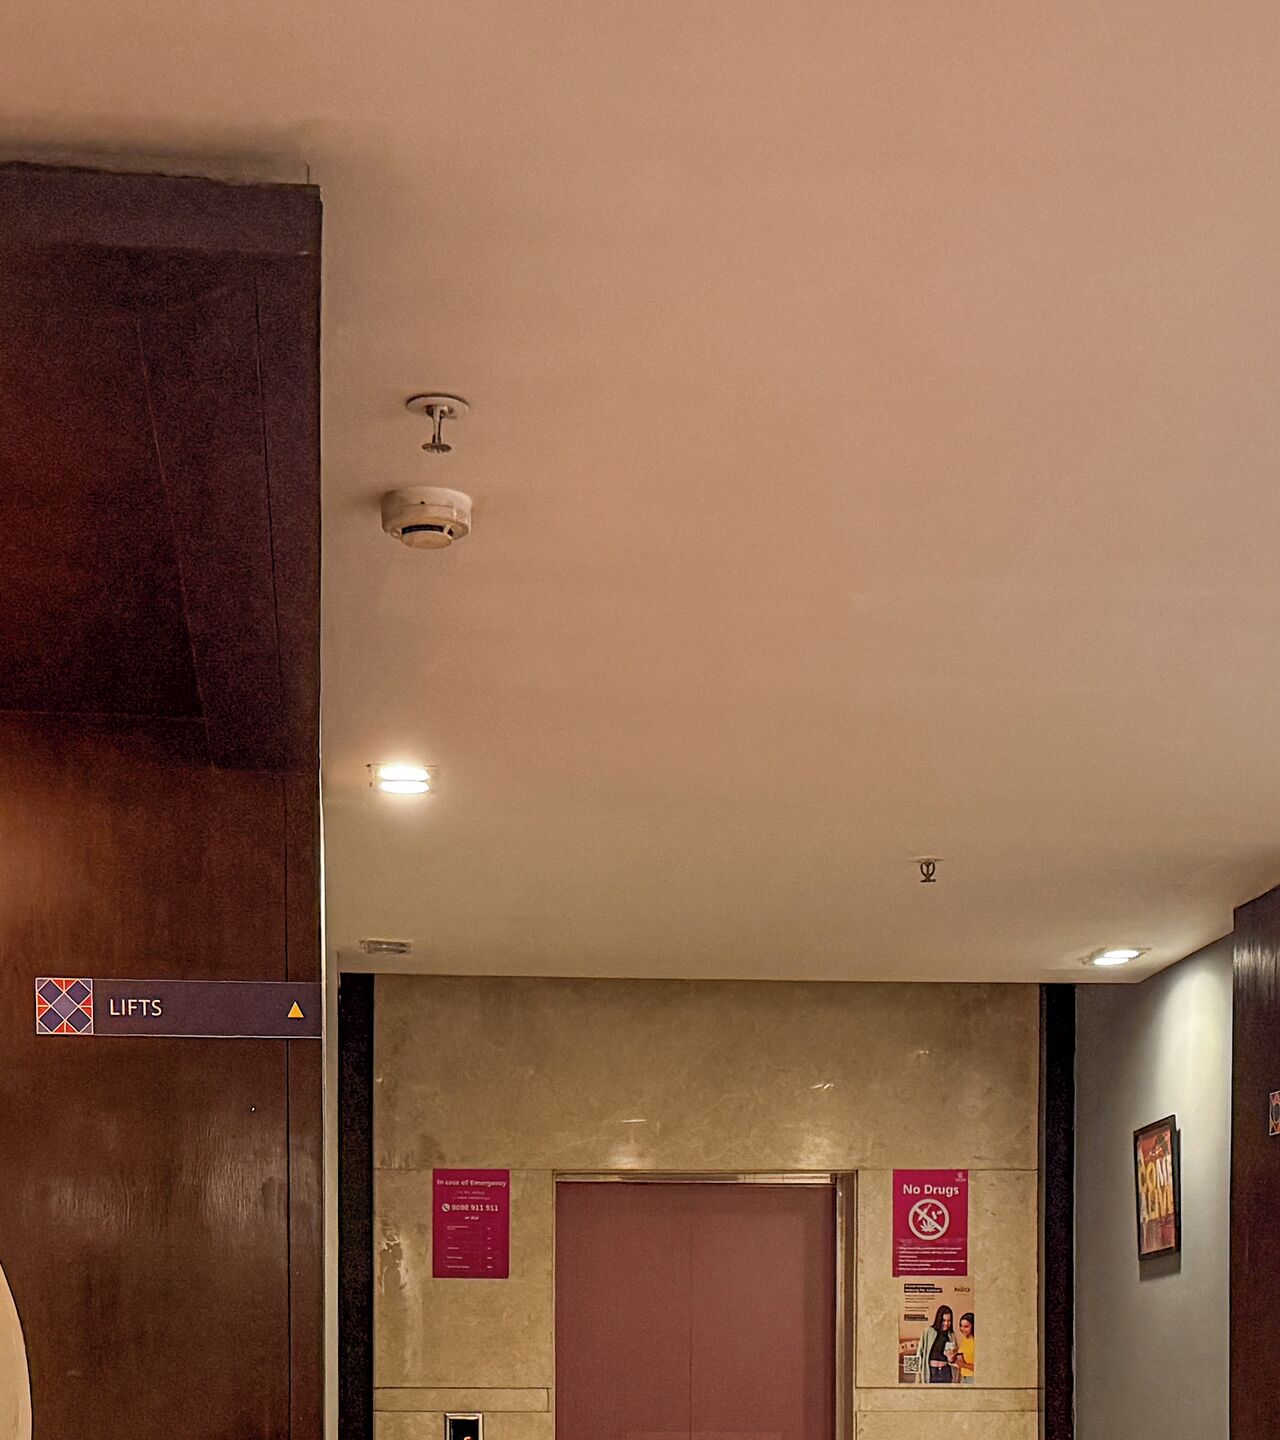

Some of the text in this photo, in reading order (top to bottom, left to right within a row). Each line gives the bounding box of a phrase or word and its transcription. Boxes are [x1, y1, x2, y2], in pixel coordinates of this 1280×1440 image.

[109, 999, 162, 1017] LIFTS
[470, 1180, 507, 1188] Emergency
[903, 1184, 960, 1198] No Drugs
